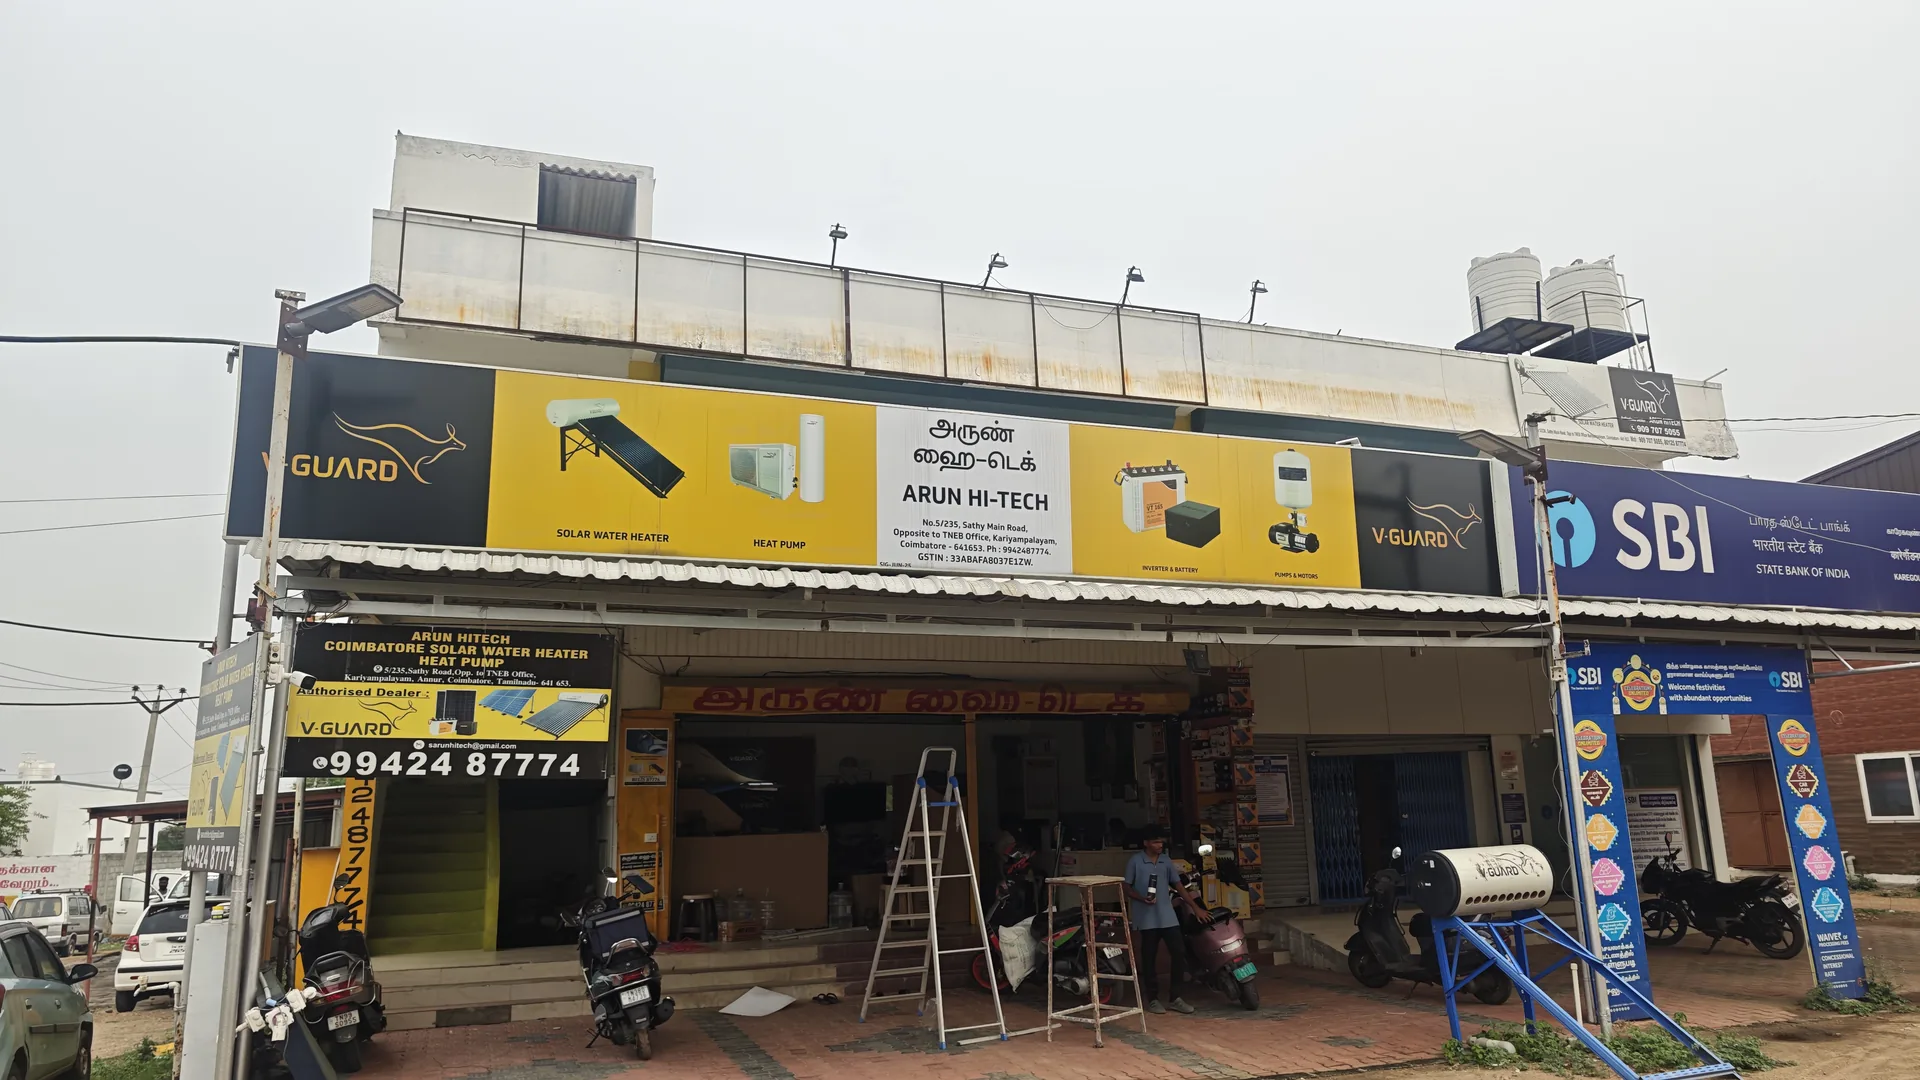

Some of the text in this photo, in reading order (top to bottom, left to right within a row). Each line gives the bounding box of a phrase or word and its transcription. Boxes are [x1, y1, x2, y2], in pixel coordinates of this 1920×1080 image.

[1620, 397, 1657, 413] V-GUARD
[929, 419, 1015, 445] அருண்
[1636, 425, 1681, 437] 909 707 5055
[913, 448, 1036, 472] ஹை-டெக்
[902, 484, 1049, 511] ARUN HI-TECH
[922, 519, 1028, 533] No.5/235, Sathy Main Road,
[1748, 515, 1851, 533] பாரத ஸ்டேட் பாங்க்
[556, 529, 669, 543] SOLAR WATER HEATER
[893, 528, 930, 538] Opposite
[942, 531, 963, 540] TNEB
[965, 533, 991, 542] Office,
[992, 534, 1058, 546] Kariyampalayam,
[1371, 526, 1448, 548] V-GUARD
[1612, 498, 1715, 574] SBI
[752, 539, 806, 549] HEAT PUMP
[900, 540, 947, 550] Coimbatore
[953, 544, 985, 553] 641653.
[986, 545, 997, 553] Ph
[1002, 546, 1052, 556] 9942487774.
[1753, 536, 1824, 555] भारतीय स्टेट बैंक
[917, 553, 944, 562] GSTIN
[950, 555, 1034, 566] 33ABAFA8037E1ZW.
[1174, 566, 1199, 574] BATTERY
[1274, 571, 1292, 579] PUMPS
[1756, 563, 1851, 579] STATE BANK OF INDIA
[411, 631, 511, 645] ARUN HITECH
[324, 640, 589, 660] COIMBATORE SOLAR WATER HEATER
[419, 655, 505, 668] HEAT PUMP
[344, 674, 415, 684] Kariyampalayam,
[417, 676, 445, 684] Annur,
[447, 677, 494, 685] Coimbatore,
[496, 678, 539, 686] Tamilnadu-
[384, 667, 430, 676] 5/235,Sathy
[432, 668, 474, 678] Road,Opp.
[486, 669, 509, 677] TNEB
[511, 671, 537, 679] Office,
[1577, 667, 1602, 685] SBI
[1780, 671, 1803, 688] SBI
[296, 687, 376, 697] Authorised
[377, 688, 422, 697] Dealer
[1667, 683, 1726, 691] Welcome festivities
[1669, 694, 1752, 703] with abundant opportunities
[300, 721, 392, 736] V-GUARD
[428, 742, 517, 750] sarunhitech@gmail.com
[330, 750, 580, 777] 99424 87774
[187, 844, 236, 872] 99424 87774
[1478, 864, 1520, 877] V-GUARD
[1817, 932, 1842, 942] WAIVER
[1821, 953, 1855, 961] CONCESSIONAL
[1823, 961, 1843, 970] INTEREST
